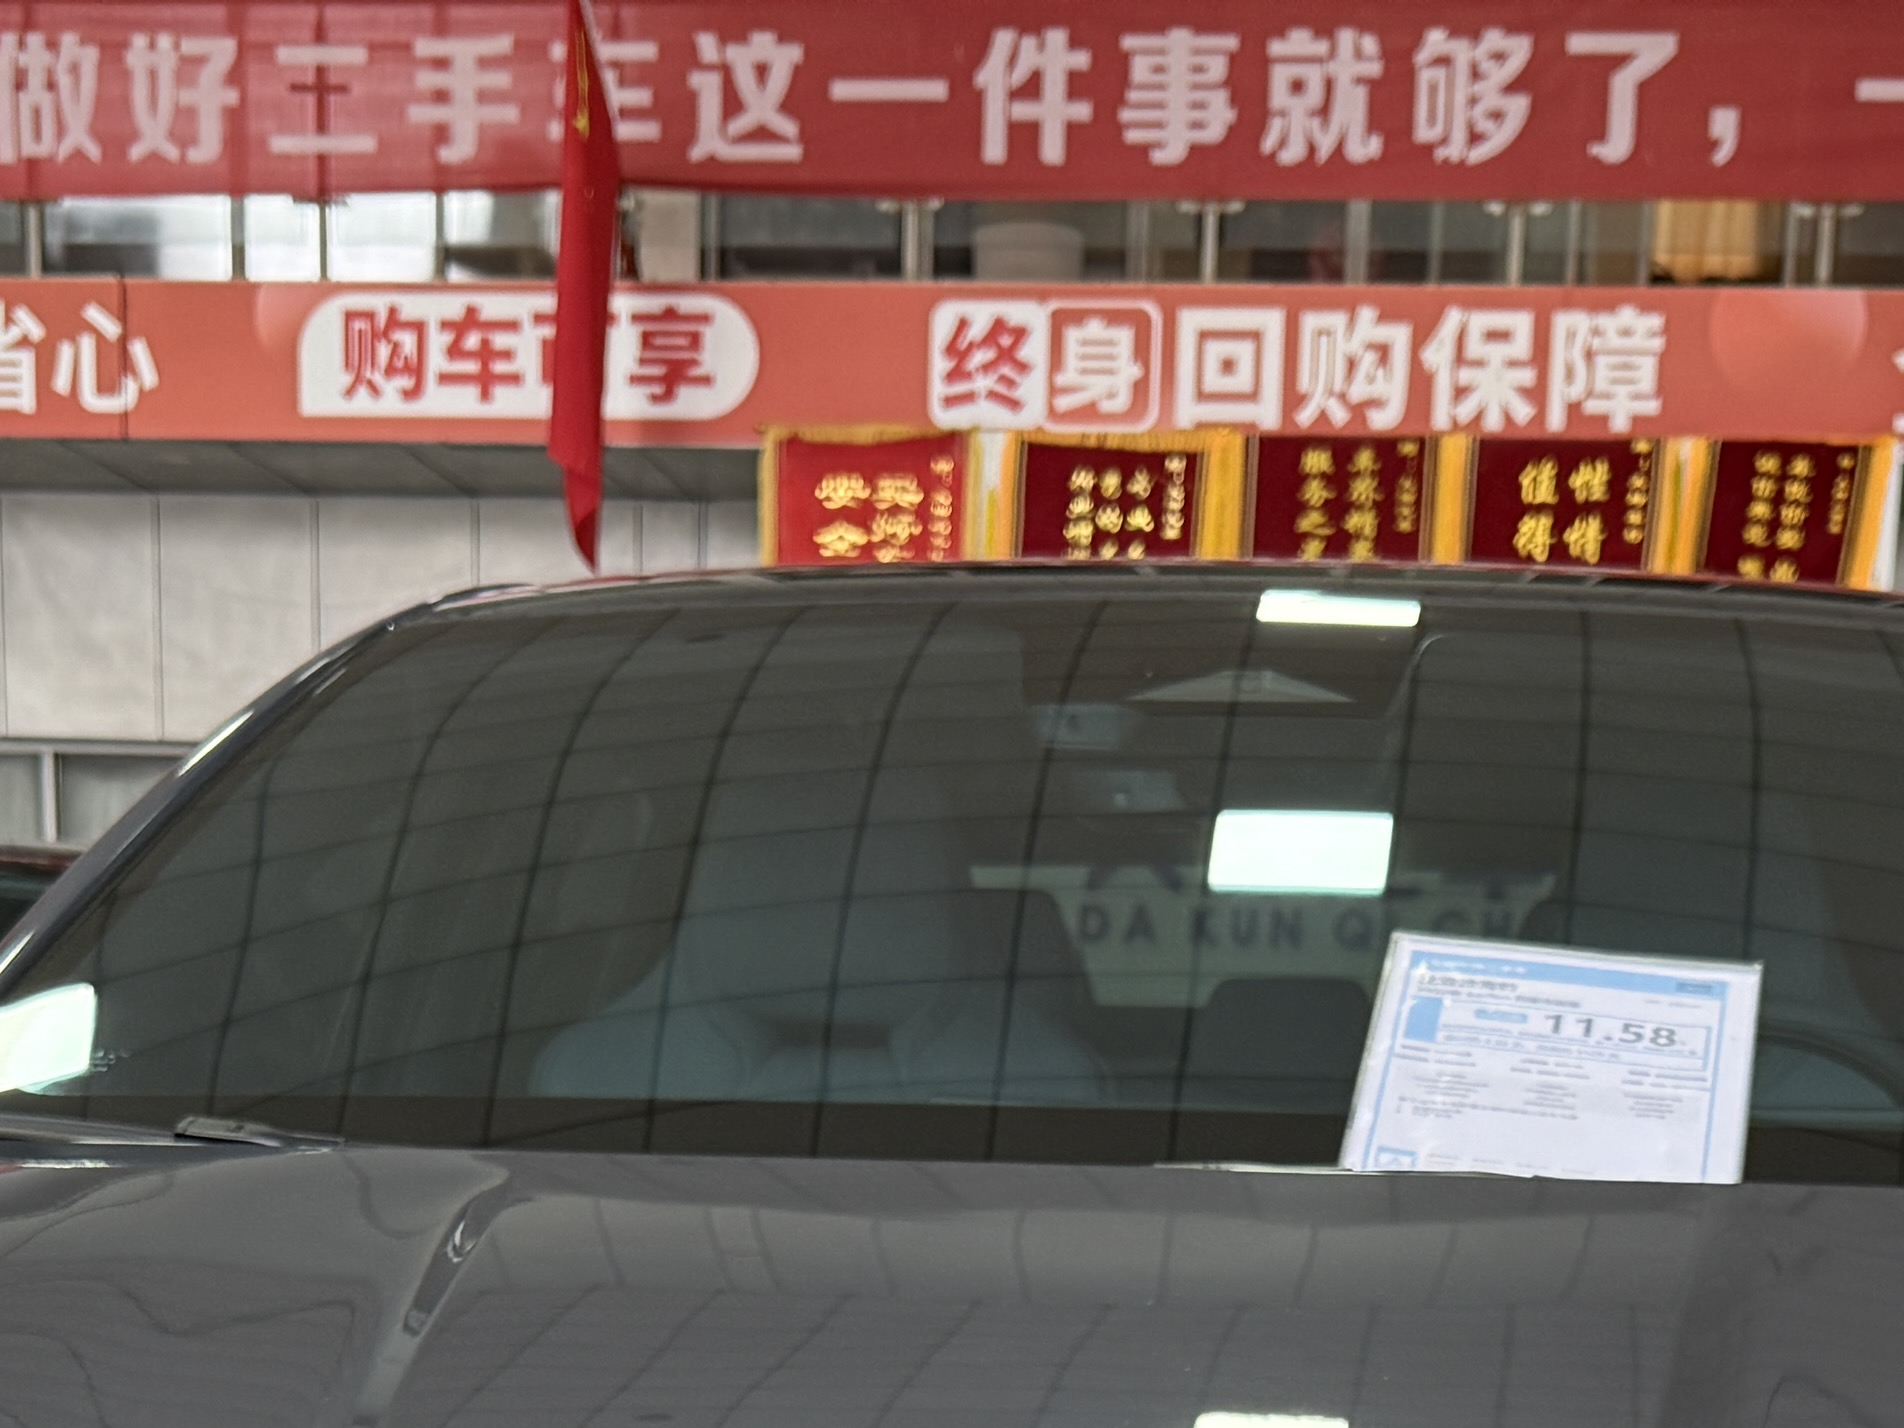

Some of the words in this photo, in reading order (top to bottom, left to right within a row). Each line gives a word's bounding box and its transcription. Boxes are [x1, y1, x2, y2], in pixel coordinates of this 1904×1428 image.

[938, 304, 1668, 434] 终身回购保障
[1543, 1012, 1678, 1049] 11.58
